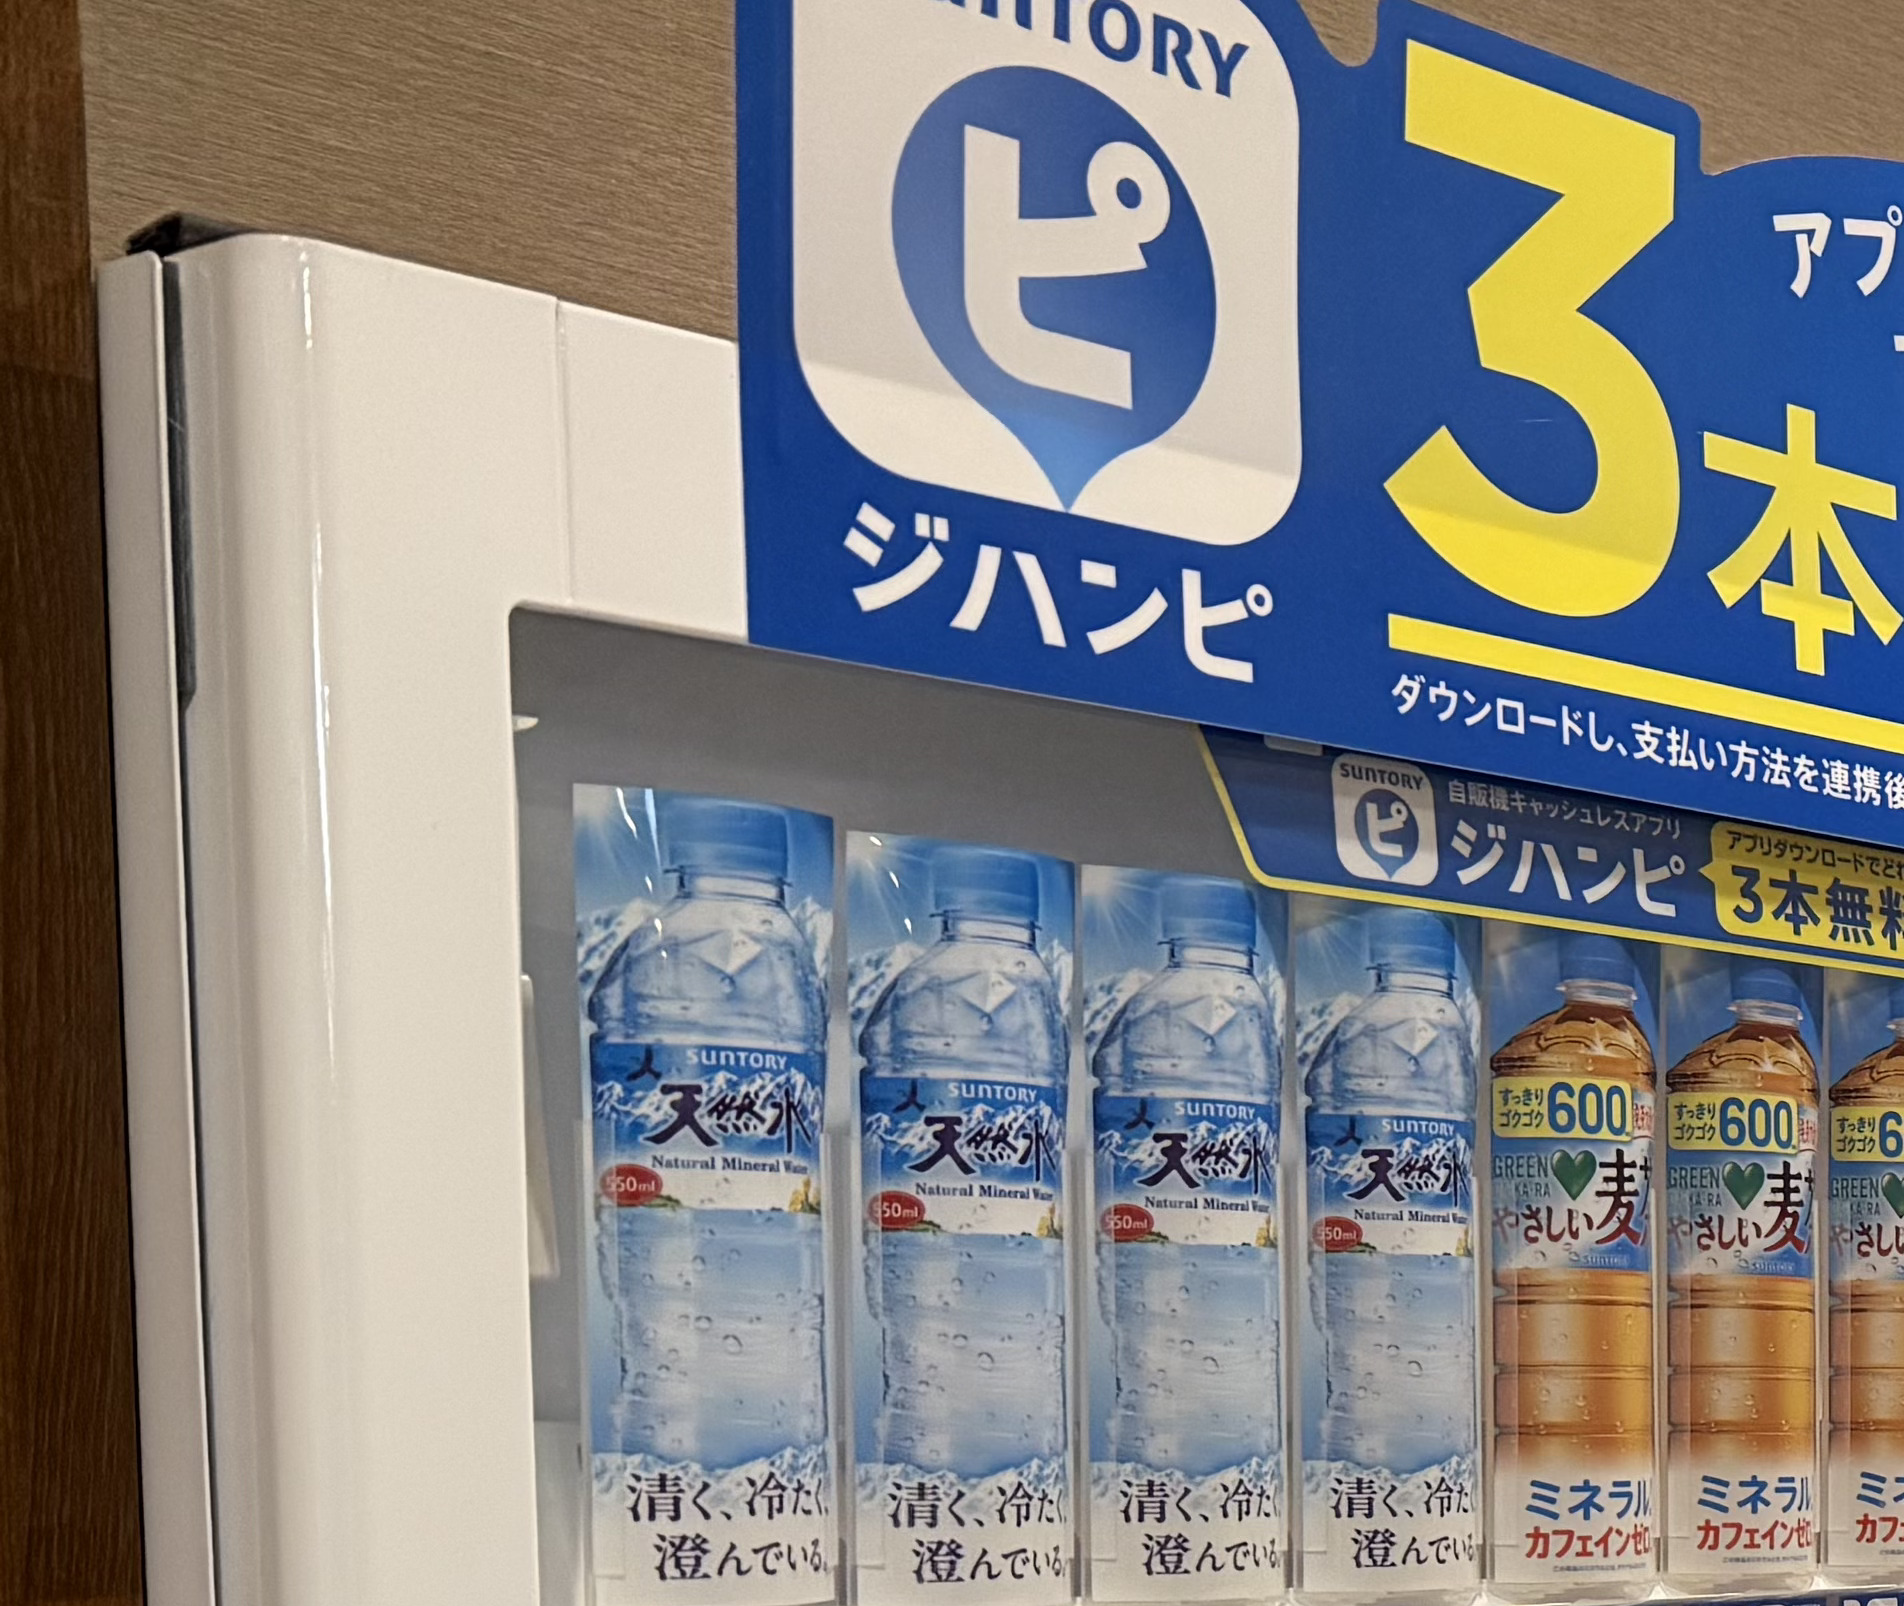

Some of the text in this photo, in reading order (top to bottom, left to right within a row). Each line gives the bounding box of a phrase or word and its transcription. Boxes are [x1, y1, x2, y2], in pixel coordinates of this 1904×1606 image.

[964, 125, 1170, 410] ピ
[843, 501, 1273, 684] ジハンピ
[1447, 779, 1682, 840] 自販機キャッシュレスアプリ
[1366, 802, 1408, 857] ピ
[1449, 817, 1687, 919] ジハンピ
[686, 1049, 787, 1070] SUNTORY
[947, 1082, 1038, 1102] SUNTORY
[1501, 1088, 1544, 1107] すっきり
[643, 1084, 811, 1153] 天然水
[1175, 1101, 1256, 1120] SUNTORY
[1548, 1081, 1627, 1136] 600
[1675, 1103, 1716, 1122] すっきり
[1382, 1118, 1454, 1136] SUNTORY
[1500, 1109, 1544, 1129] ゴクゴク
[1719, 1097, 1793, 1149] 600
[1836, 1116, 1876, 1135] すっきり
[1674, 1123, 1716, 1142] ゴクゴク
[1836, 1135, 1876, 1154] ゴクゴク
[652, 1155, 780, 1174] Natural Mineral
[1137, 1133, 1266, 1195] 天然水
[1347, 1148, 1469, 1206] 天然水
[915, 1181, 1029, 1199] Natural Mineral
[1144, 1195, 1250, 1213] Natural Mineral
